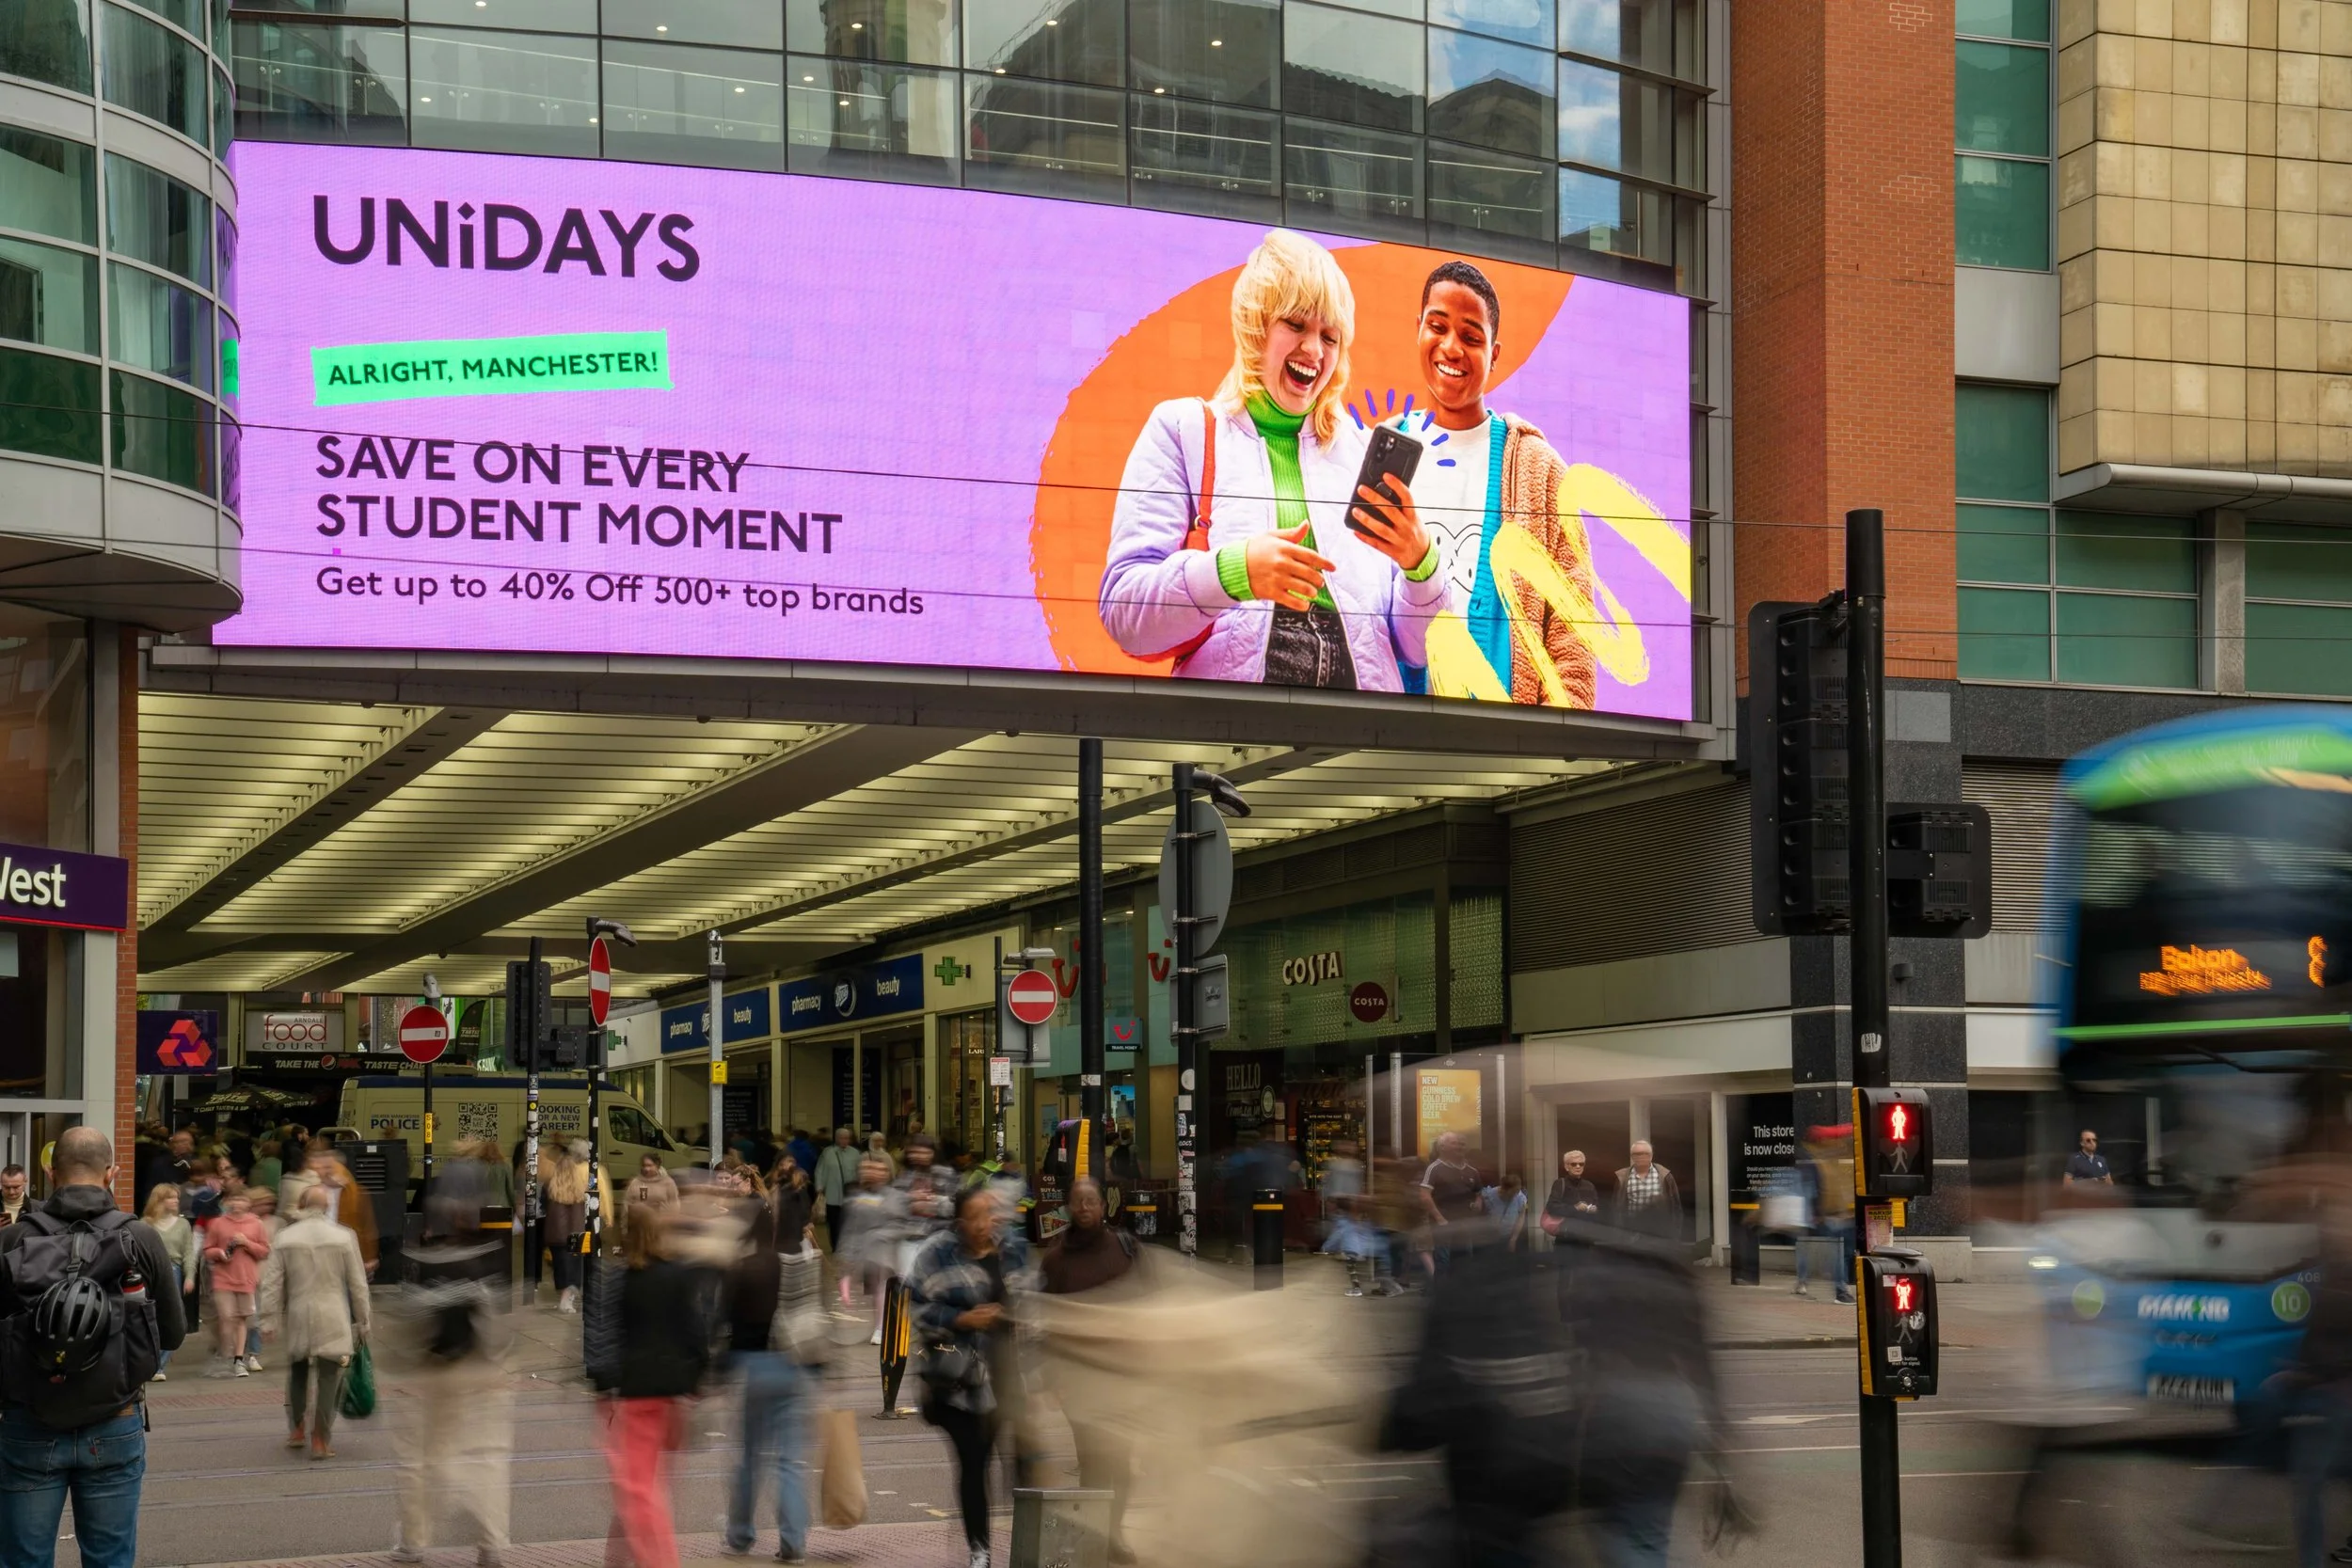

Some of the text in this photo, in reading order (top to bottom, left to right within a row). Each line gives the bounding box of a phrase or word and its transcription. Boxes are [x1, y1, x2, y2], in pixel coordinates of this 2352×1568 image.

[328, 352, 659, 386] ALRIGHT, MANCHESTER!
[316, 436, 750, 493] SAVE ON EVERY
[316, 494, 842, 554] STUDENT MOMENT
[316, 567, 924, 617] Get up to 40% Off 500+ top brands
[1282, 952, 1343, 986] COSTA
[792, 993, 820, 1015] pharmacy
[877, 976, 900, 997] beauty
[1354, 997, 1385, 1006] COSTA
[734, 1006, 752, 1024] beauty
[264, 1014, 327, 1041] food
[670, 1021, 692, 1038] pharmacy
[262, 1042, 327, 1051] COURT
[275, 1059, 302, 1069] TAKE
[304, 1059, 320, 1069] THE
[364, 1061, 399, 1070] TASTE
[1226, 1062, 1261, 1091] HELLO
[1422, 1076, 1438, 1085] NEW
[1422, 1085, 1457, 1095] GUINNESS
[1422, 1095, 1461, 1103] COLD BREW
[537, 1105, 581, 1115] OOKING
[1422, 1102, 1448, 1111] COFFEE
[371, 1118, 421, 1130] POLICE
[539, 1122, 581, 1132] AREER?
[1753, 1124, 1795, 1138] This store
[1743, 1142, 1795, 1155] is now close
[2280, 1292, 2301, 1314] 10
